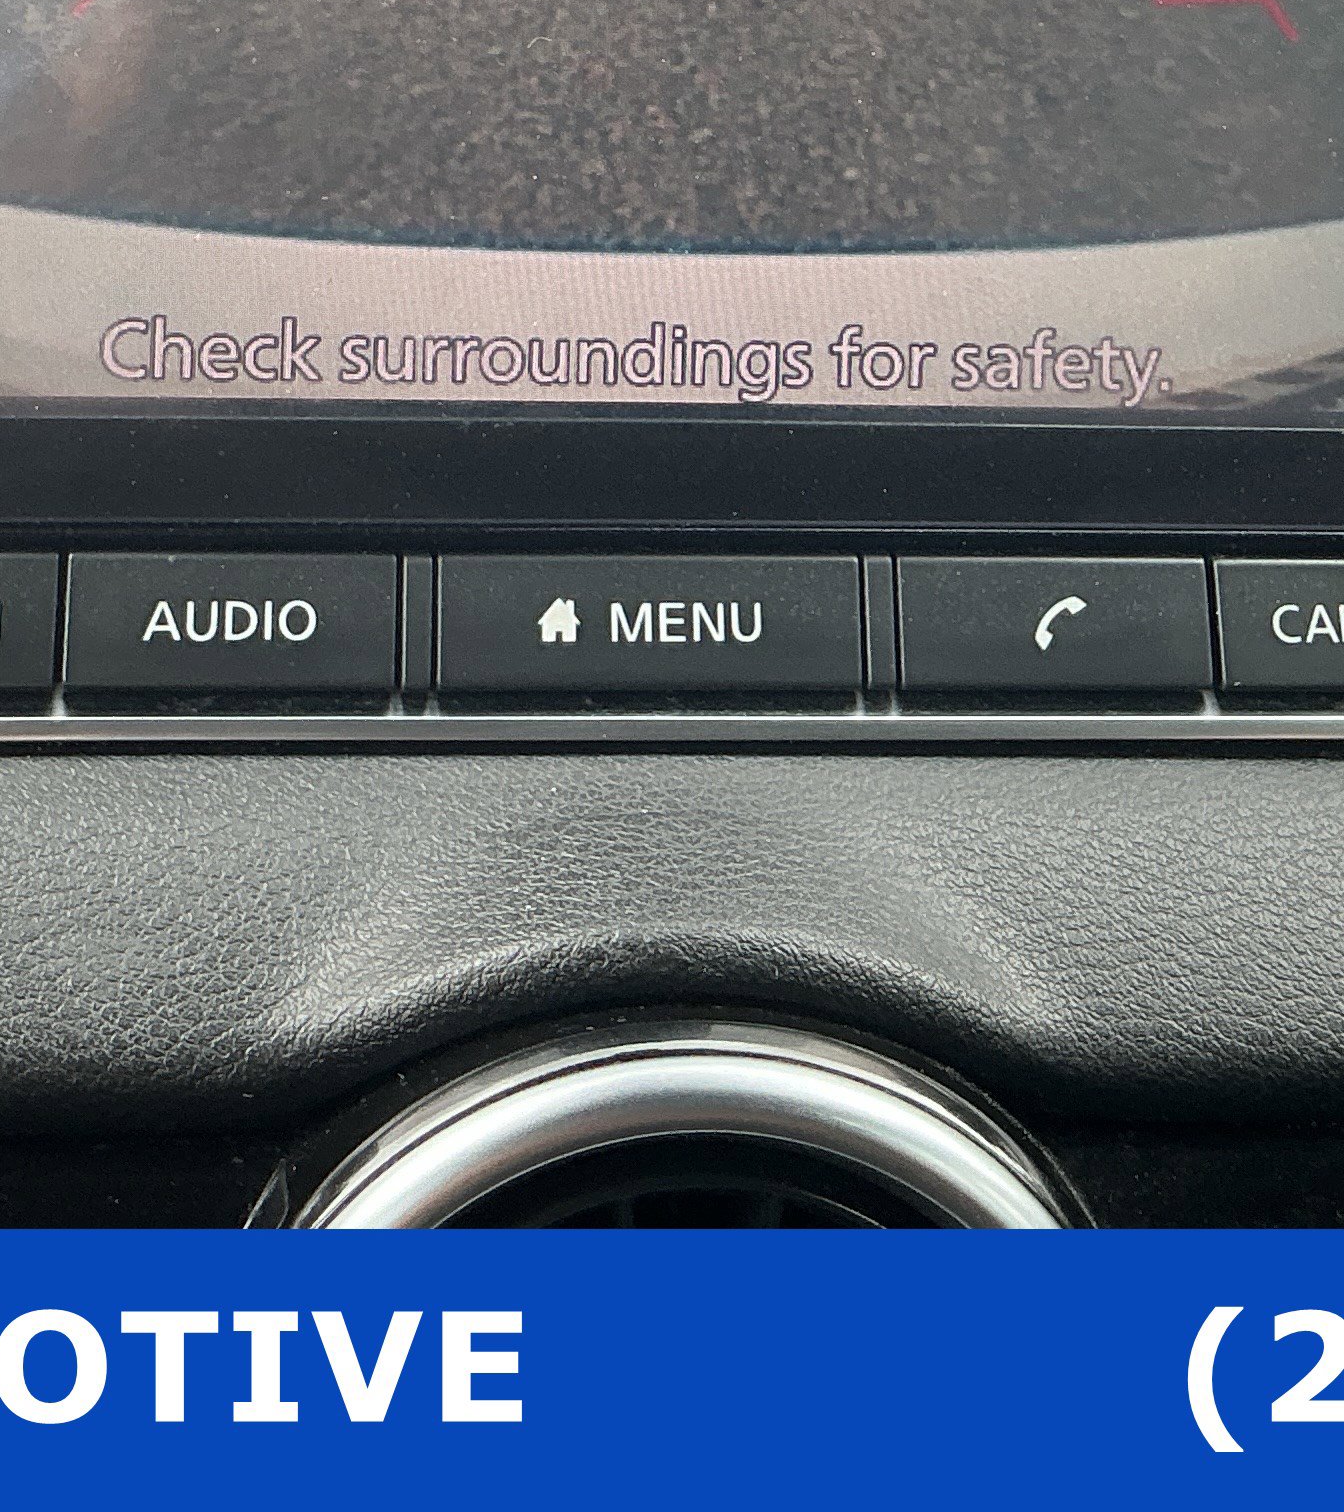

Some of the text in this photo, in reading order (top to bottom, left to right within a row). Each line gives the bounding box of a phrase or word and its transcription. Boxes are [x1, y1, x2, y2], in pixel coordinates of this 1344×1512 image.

[99, 314, 1174, 407] Check surroundings for safety.
[141, 598, 319, 644] AUDIO
[608, 599, 765, 645] MENU
